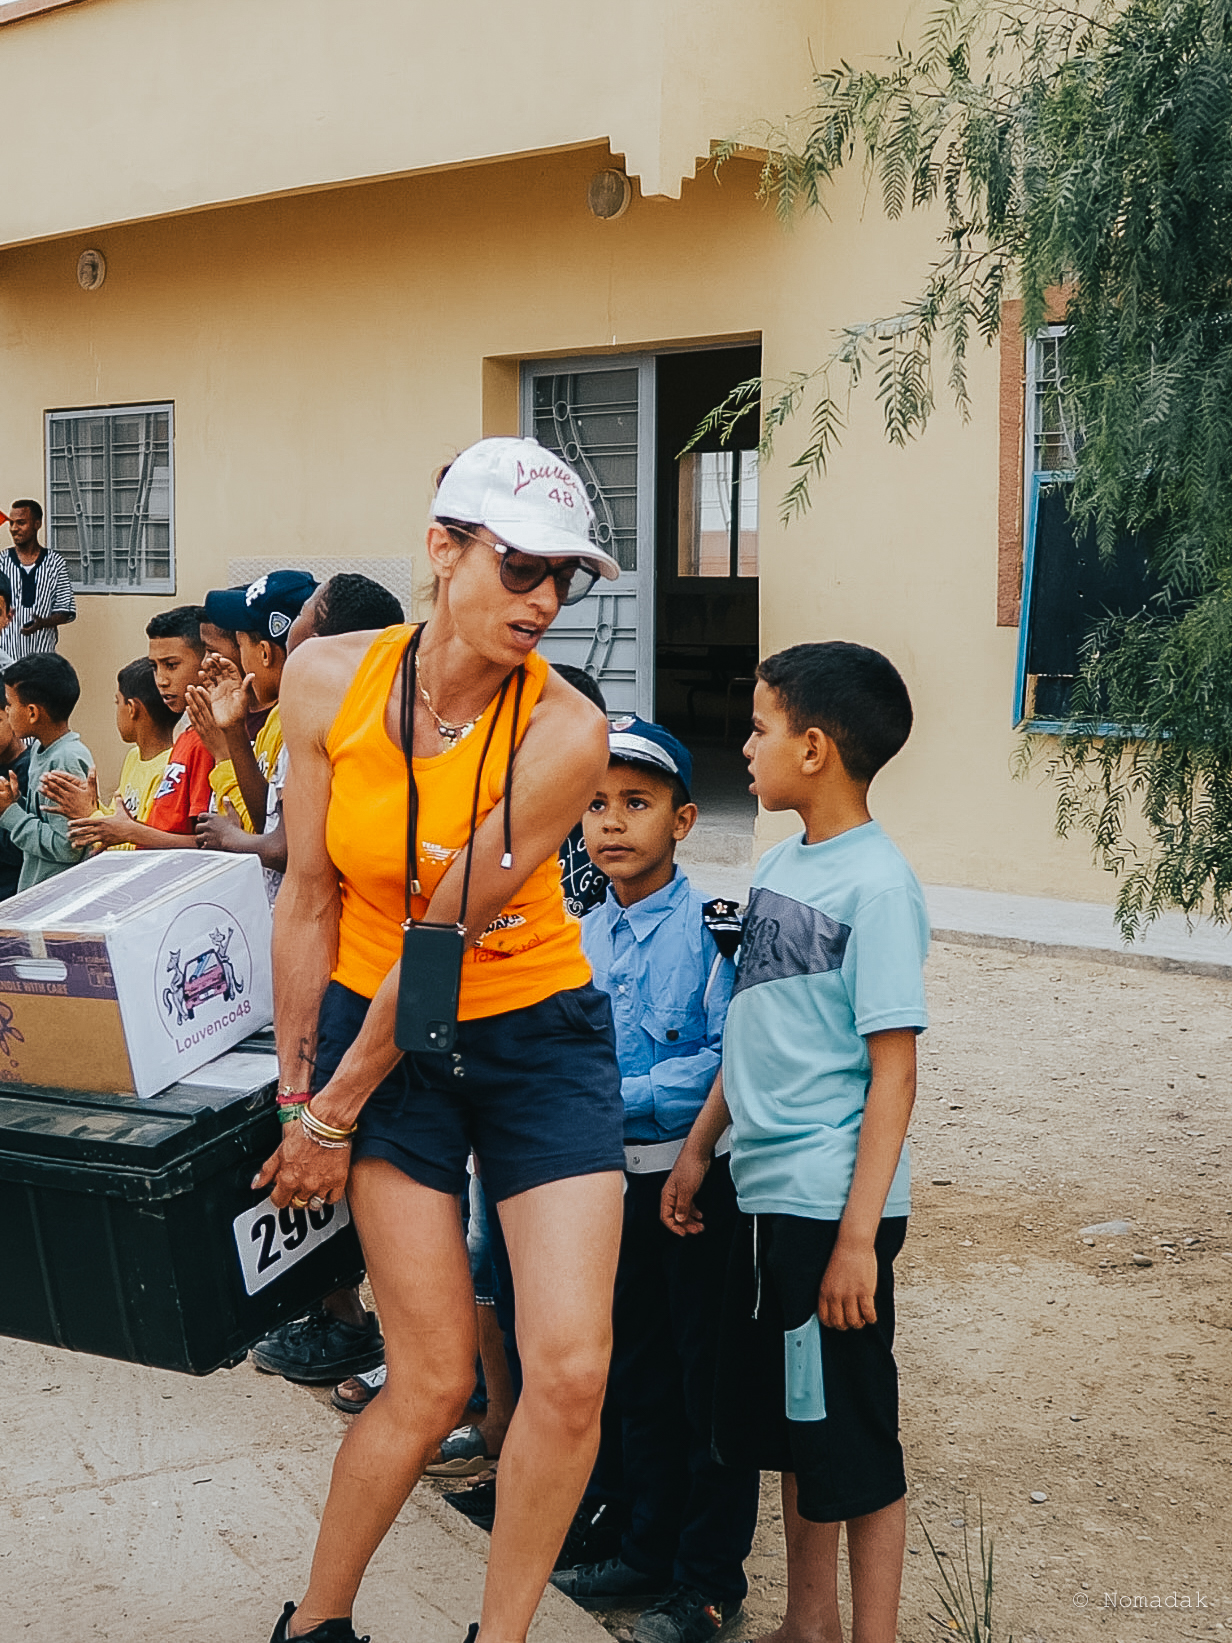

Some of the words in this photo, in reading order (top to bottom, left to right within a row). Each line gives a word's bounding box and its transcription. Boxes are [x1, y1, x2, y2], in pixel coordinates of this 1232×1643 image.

[549, 488, 574, 508] 48
[23, 981, 46, 994] WITH
[46, 983, 69, 995] CARE
[175, 1000, 252, 1054] Louvenco48
